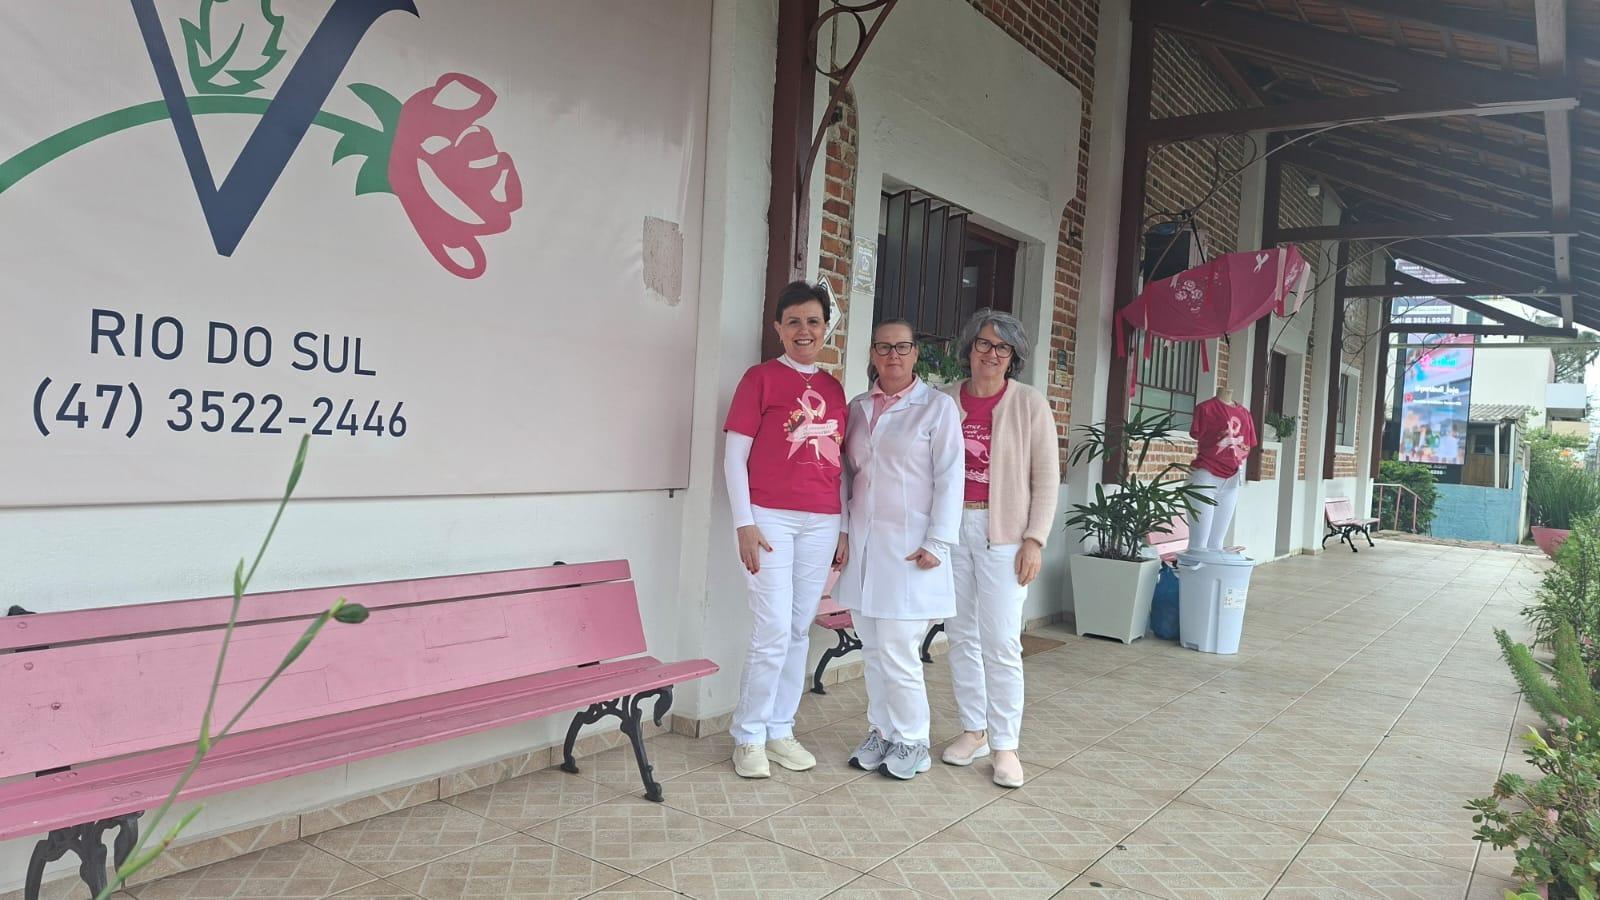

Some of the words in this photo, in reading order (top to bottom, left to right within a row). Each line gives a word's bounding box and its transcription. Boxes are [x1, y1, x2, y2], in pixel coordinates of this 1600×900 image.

[90, 308, 184, 361] RIO
[207, 321, 272, 368] DO
[291, 331, 377, 377] SUL
[33, 376, 143, 439] (47)
[166, 388, 407, 438] 3522-2446
